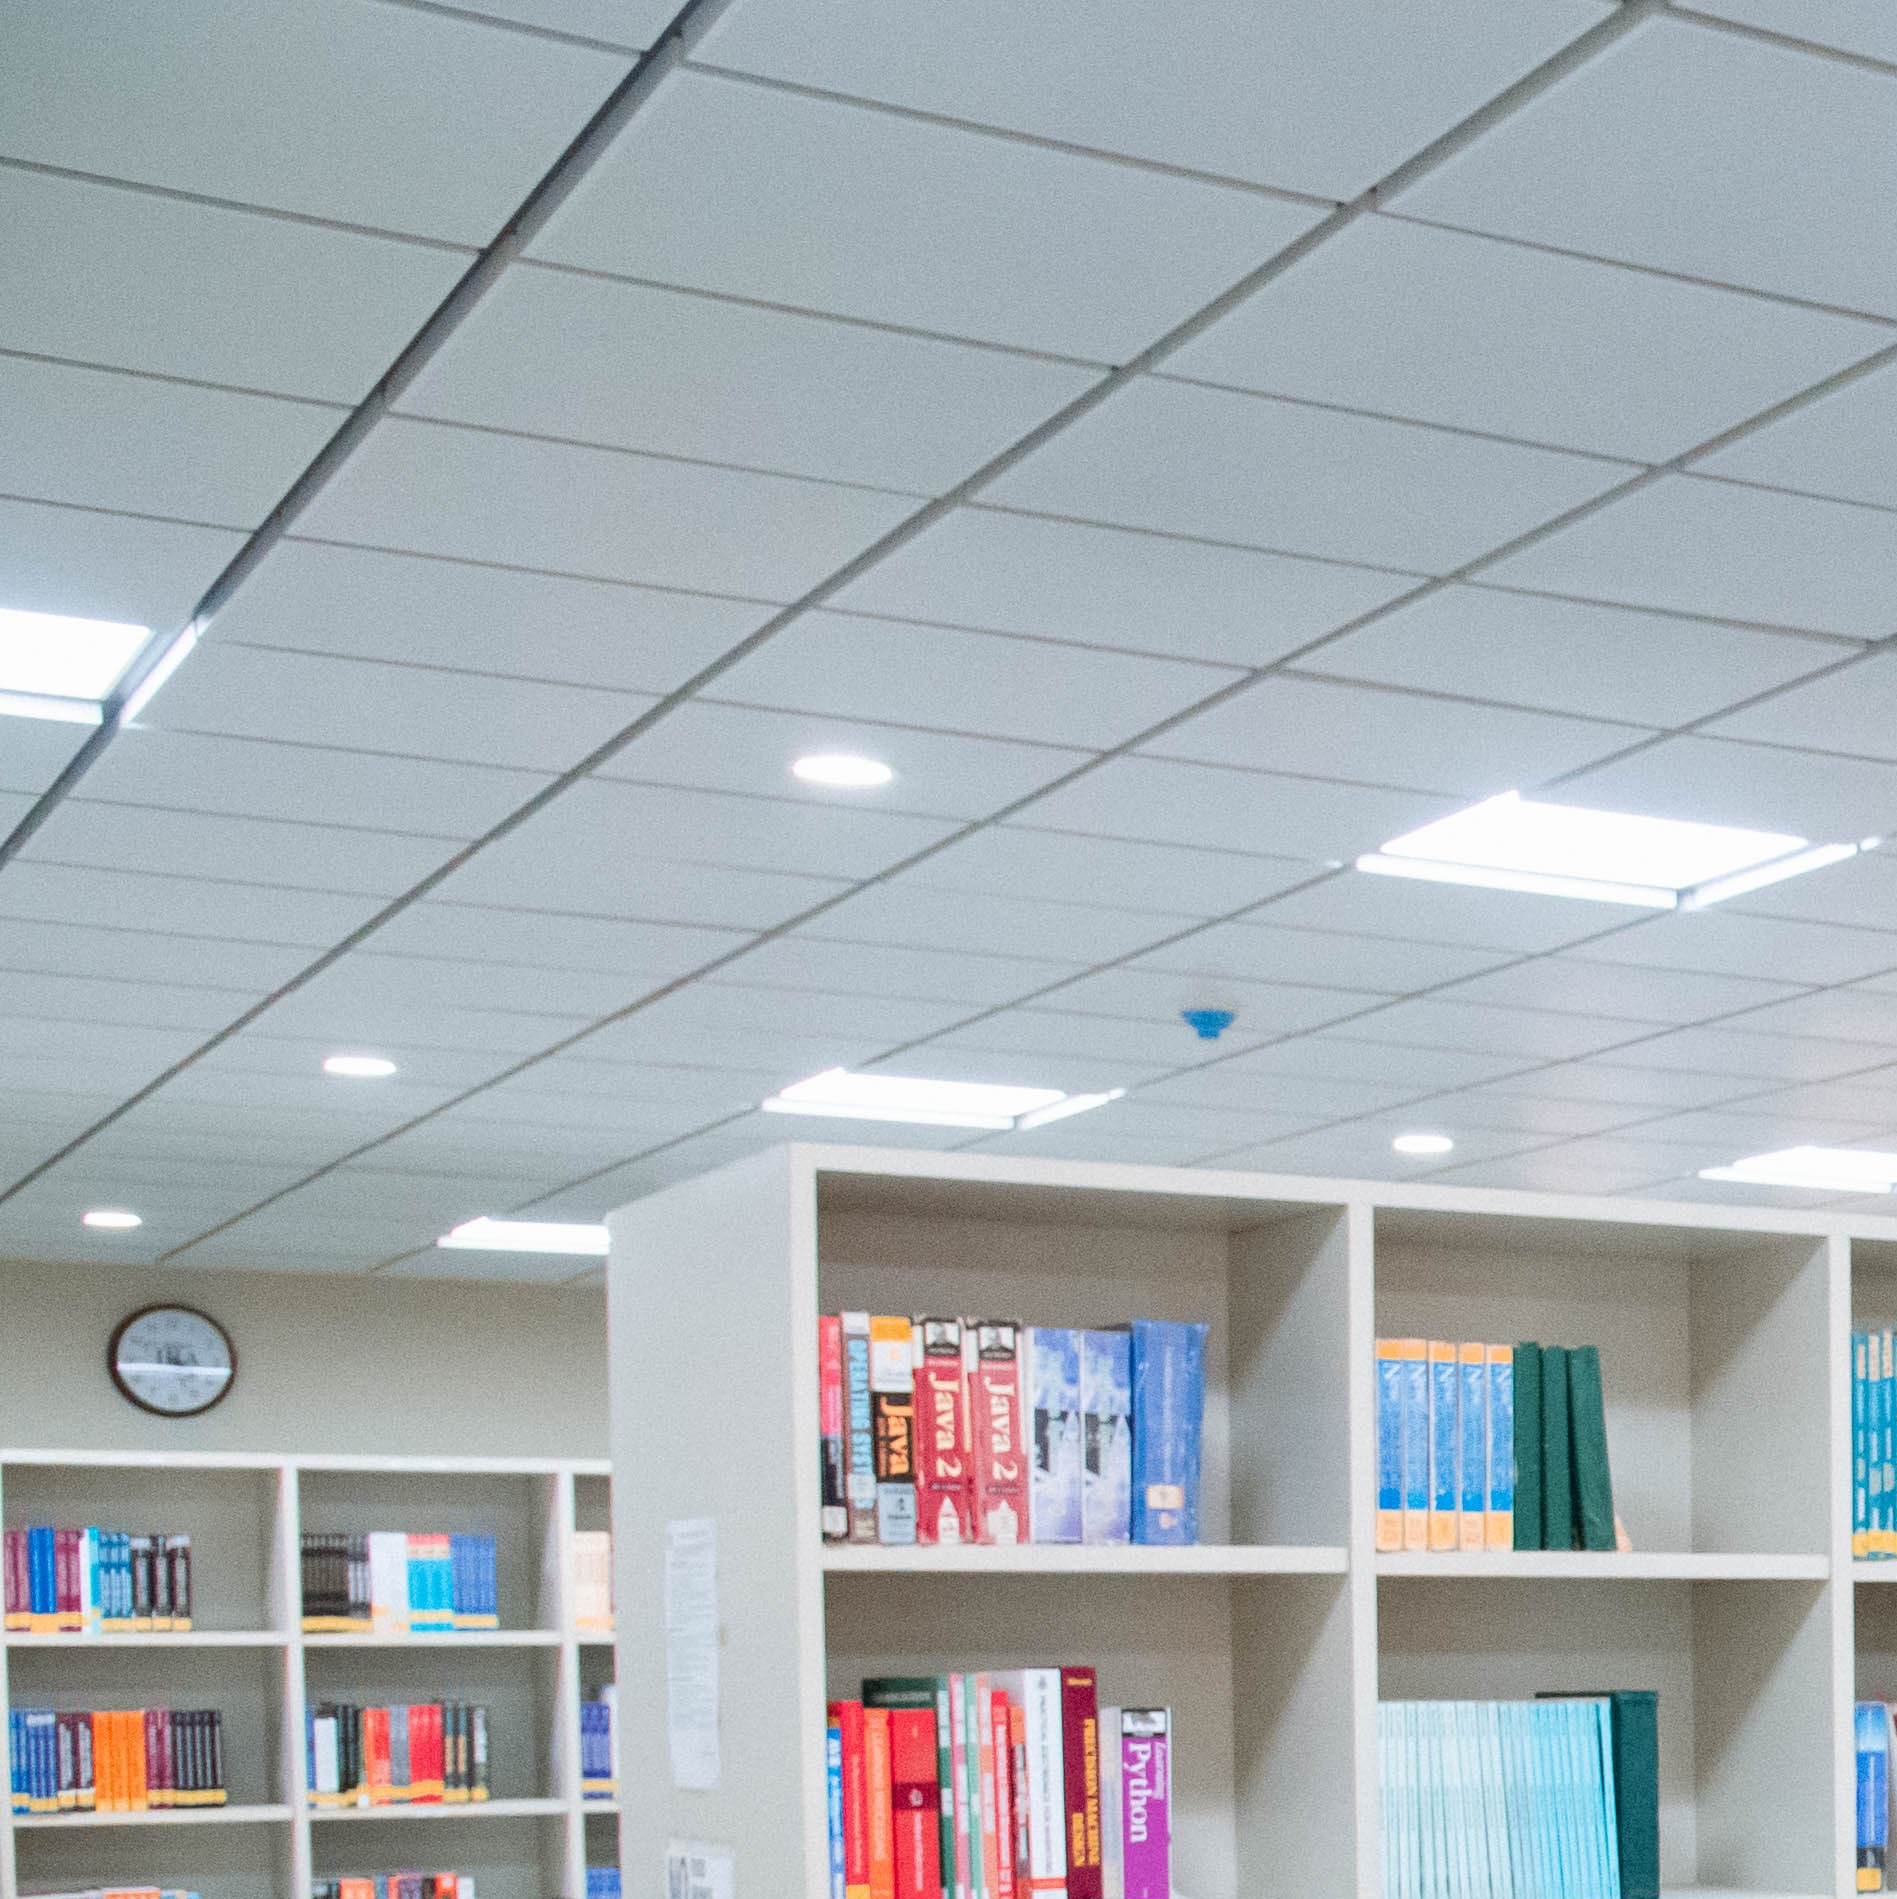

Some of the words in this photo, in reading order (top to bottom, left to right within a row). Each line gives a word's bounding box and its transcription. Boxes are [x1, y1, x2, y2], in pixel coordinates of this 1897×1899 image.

[880, 1397, 914, 1474] Java
[930, 1373, 960, 1451] Java
[985, 1378, 1015, 1454] Java
[938, 1458, 962, 1478] 2
[994, 1461, 1018, 1481] 2
[1123, 1742, 1152, 1843] Python
